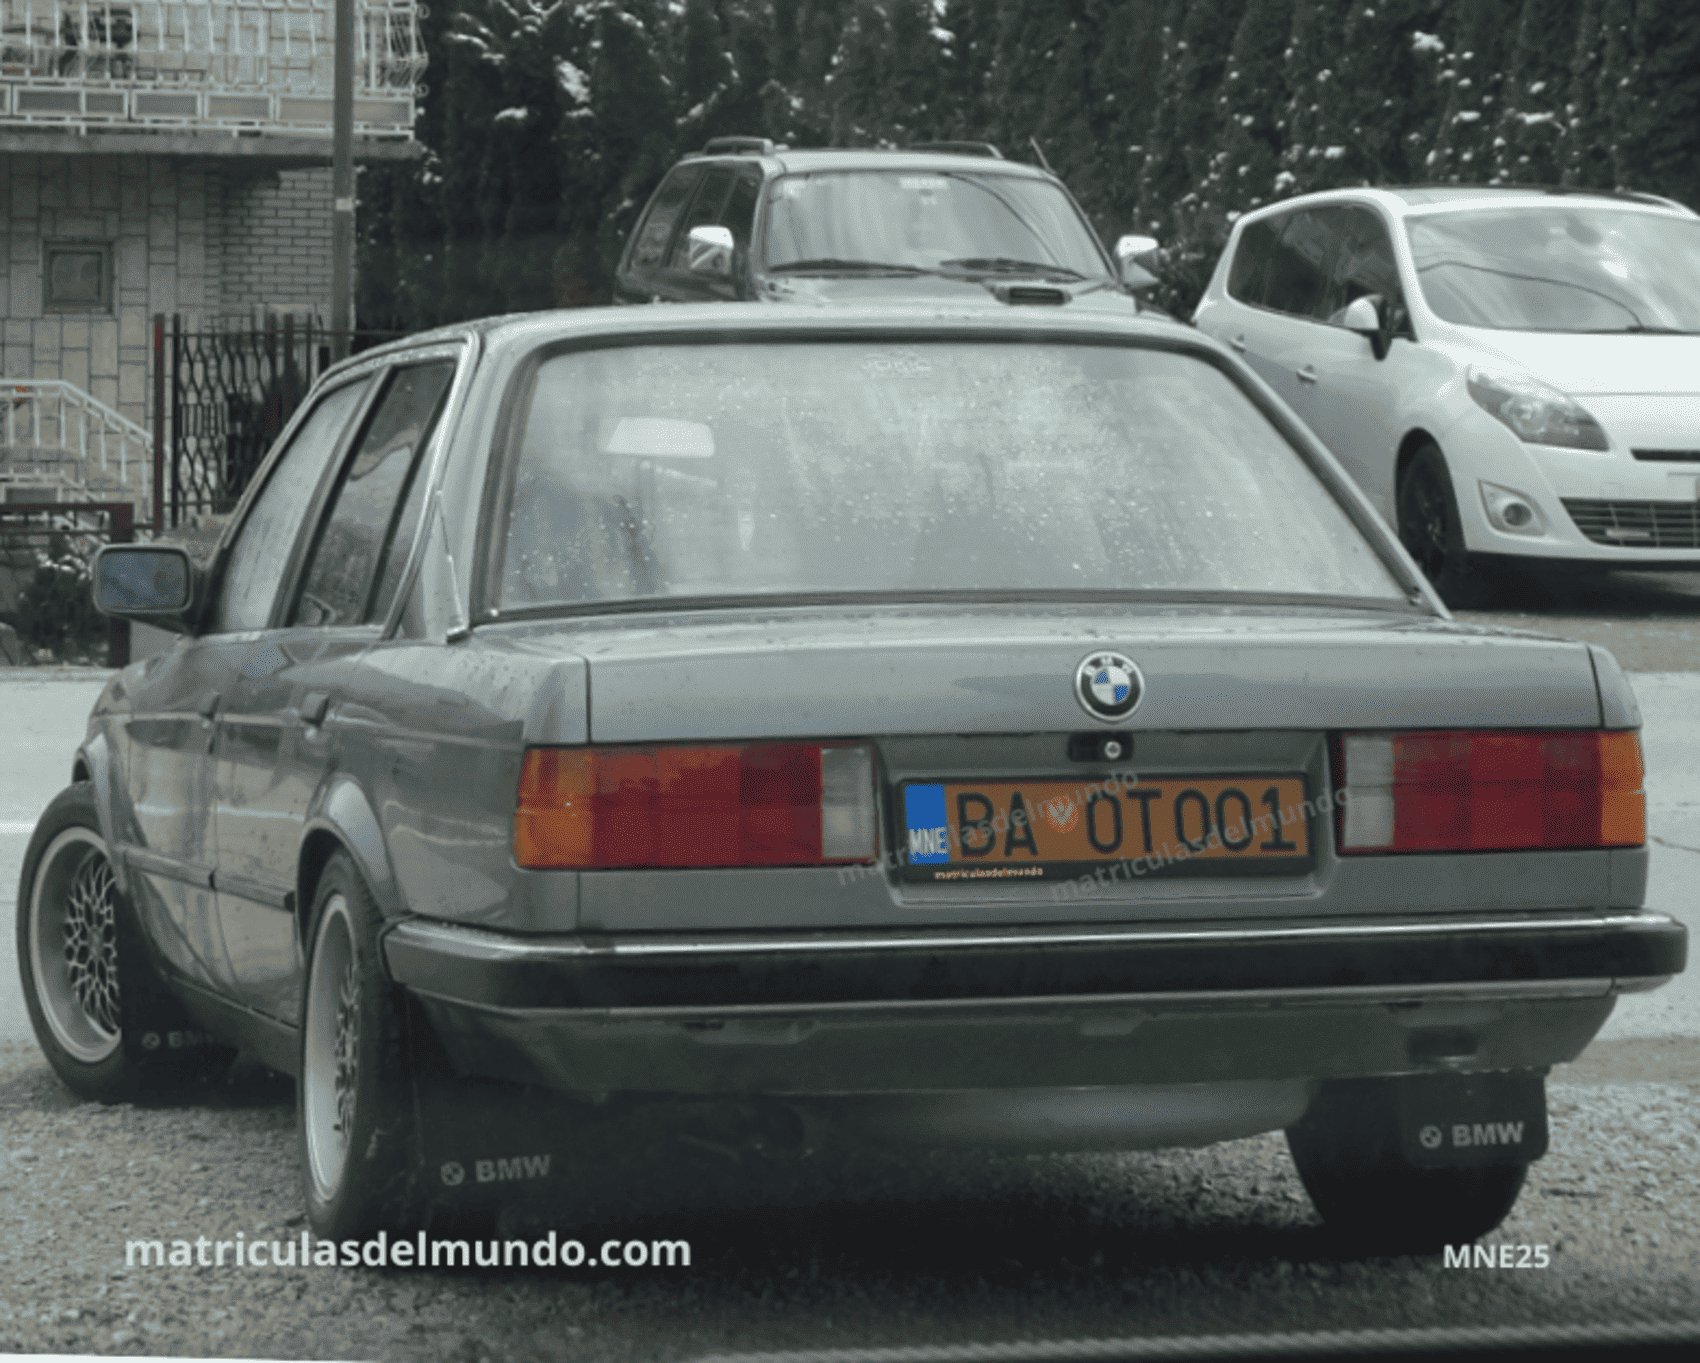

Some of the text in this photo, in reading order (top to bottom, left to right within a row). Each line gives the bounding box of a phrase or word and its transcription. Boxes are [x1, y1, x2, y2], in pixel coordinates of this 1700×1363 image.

[957, 791, 1038, 857] BA
[909, 827, 948, 855] MNE
[1452, 1121, 1525, 1147] BMW
[475, 1154, 552, 1183] BMW
